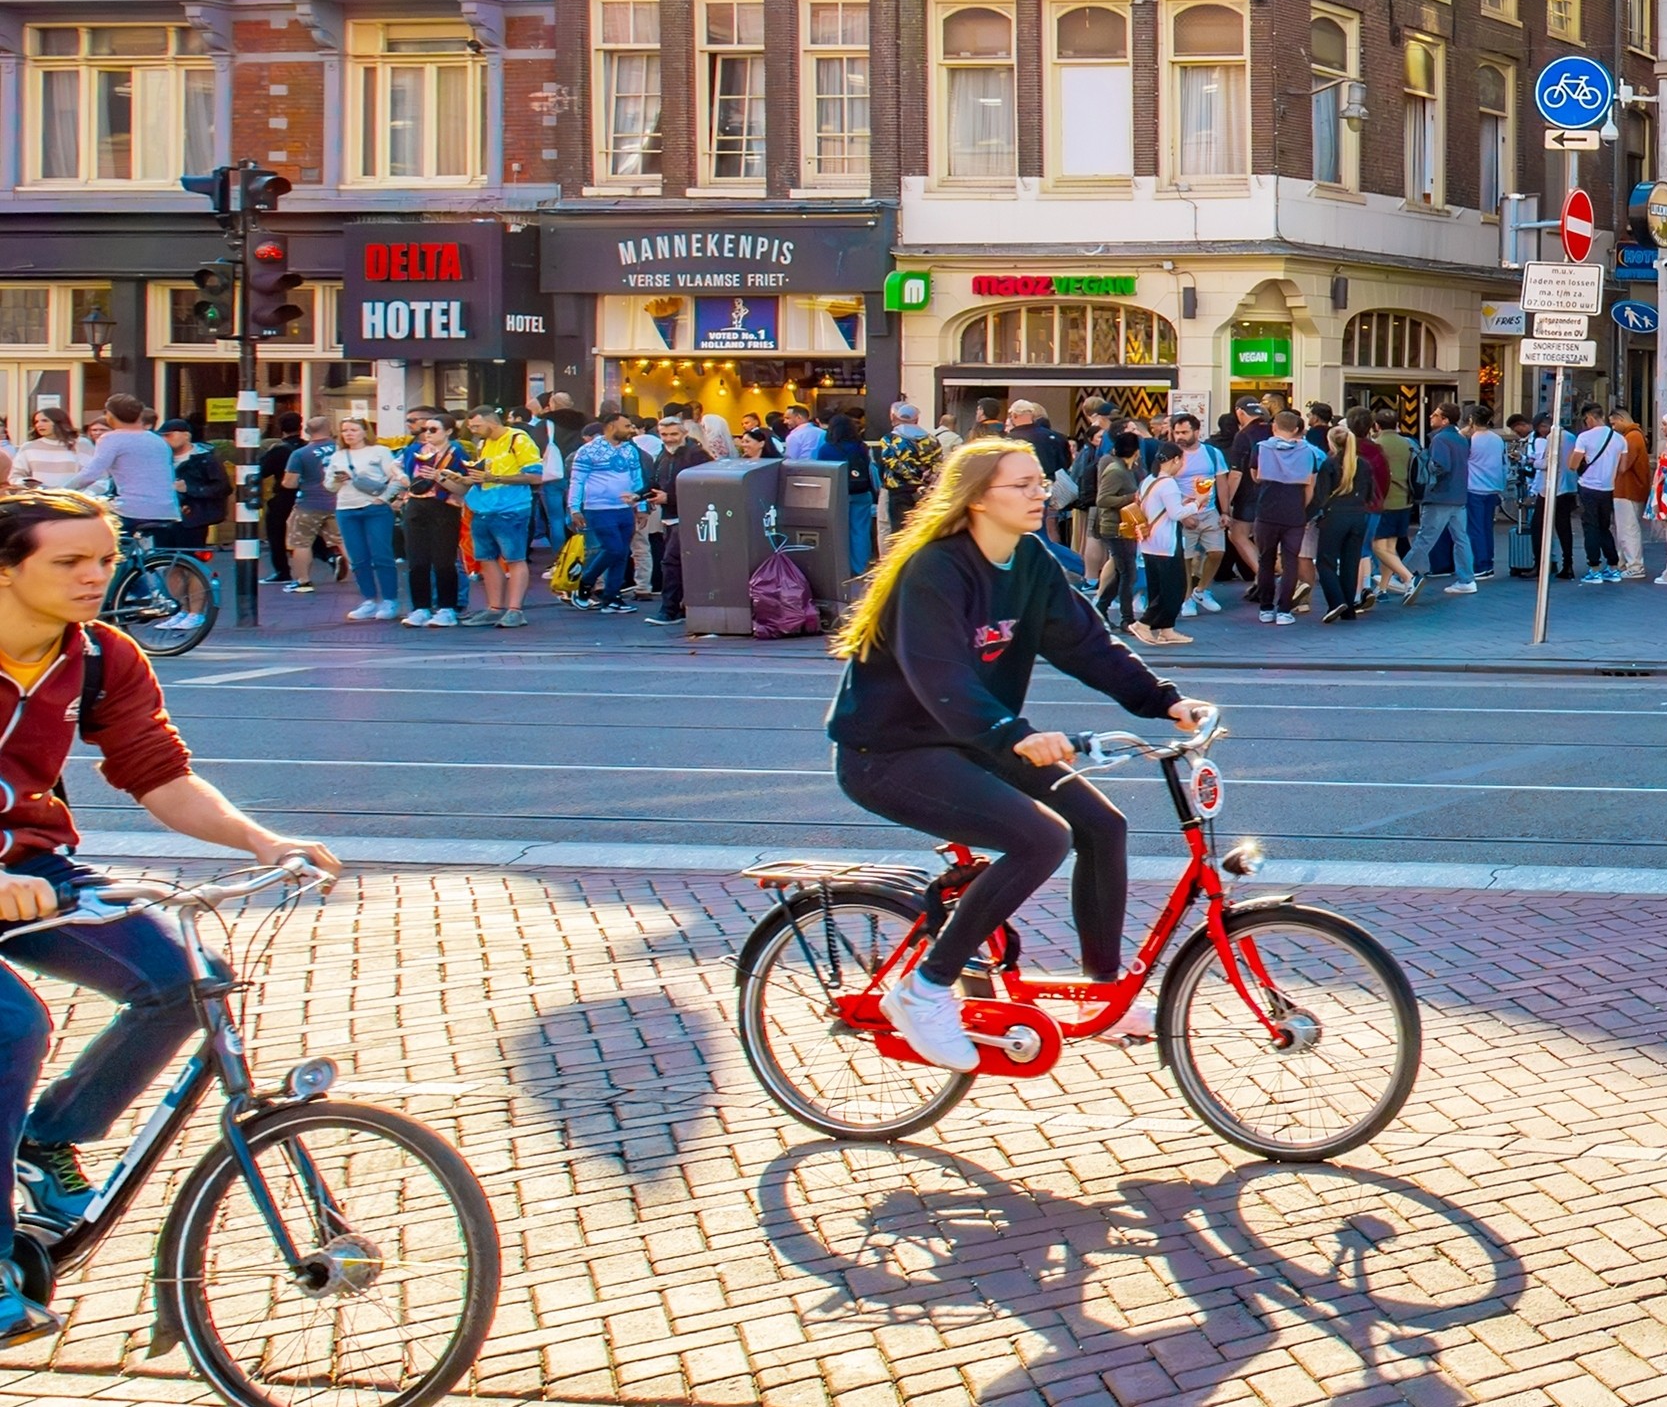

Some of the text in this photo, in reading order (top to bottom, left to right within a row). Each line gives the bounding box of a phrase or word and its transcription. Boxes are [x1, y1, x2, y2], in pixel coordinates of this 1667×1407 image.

[618, 233, 795, 266] MANNEKENPIS
[365, 243, 463, 281] DELTA
[677, 274, 740, 287] VLAAMSE
[972, 275, 1137, 296] maoz VEGAN
[1529, 277, 1554, 286] laden
[1568, 279, 1596, 287] lossen
[362, 300, 467, 340] HOTEL
[506, 314, 546, 333] HOTEL
[1495, 315, 1522, 325] FRIES
[709, 331, 739, 340] VOTED
[701, 341, 774, 349] HOLLAND FRIES
[1533, 342, 1579, 351] SNORFIETSEN
[1239, 352, 1268, 362] VEGAN
[1525, 353, 1588, 362] NIET TOEGESTAAN
[564, 365, 577, 375] 41
